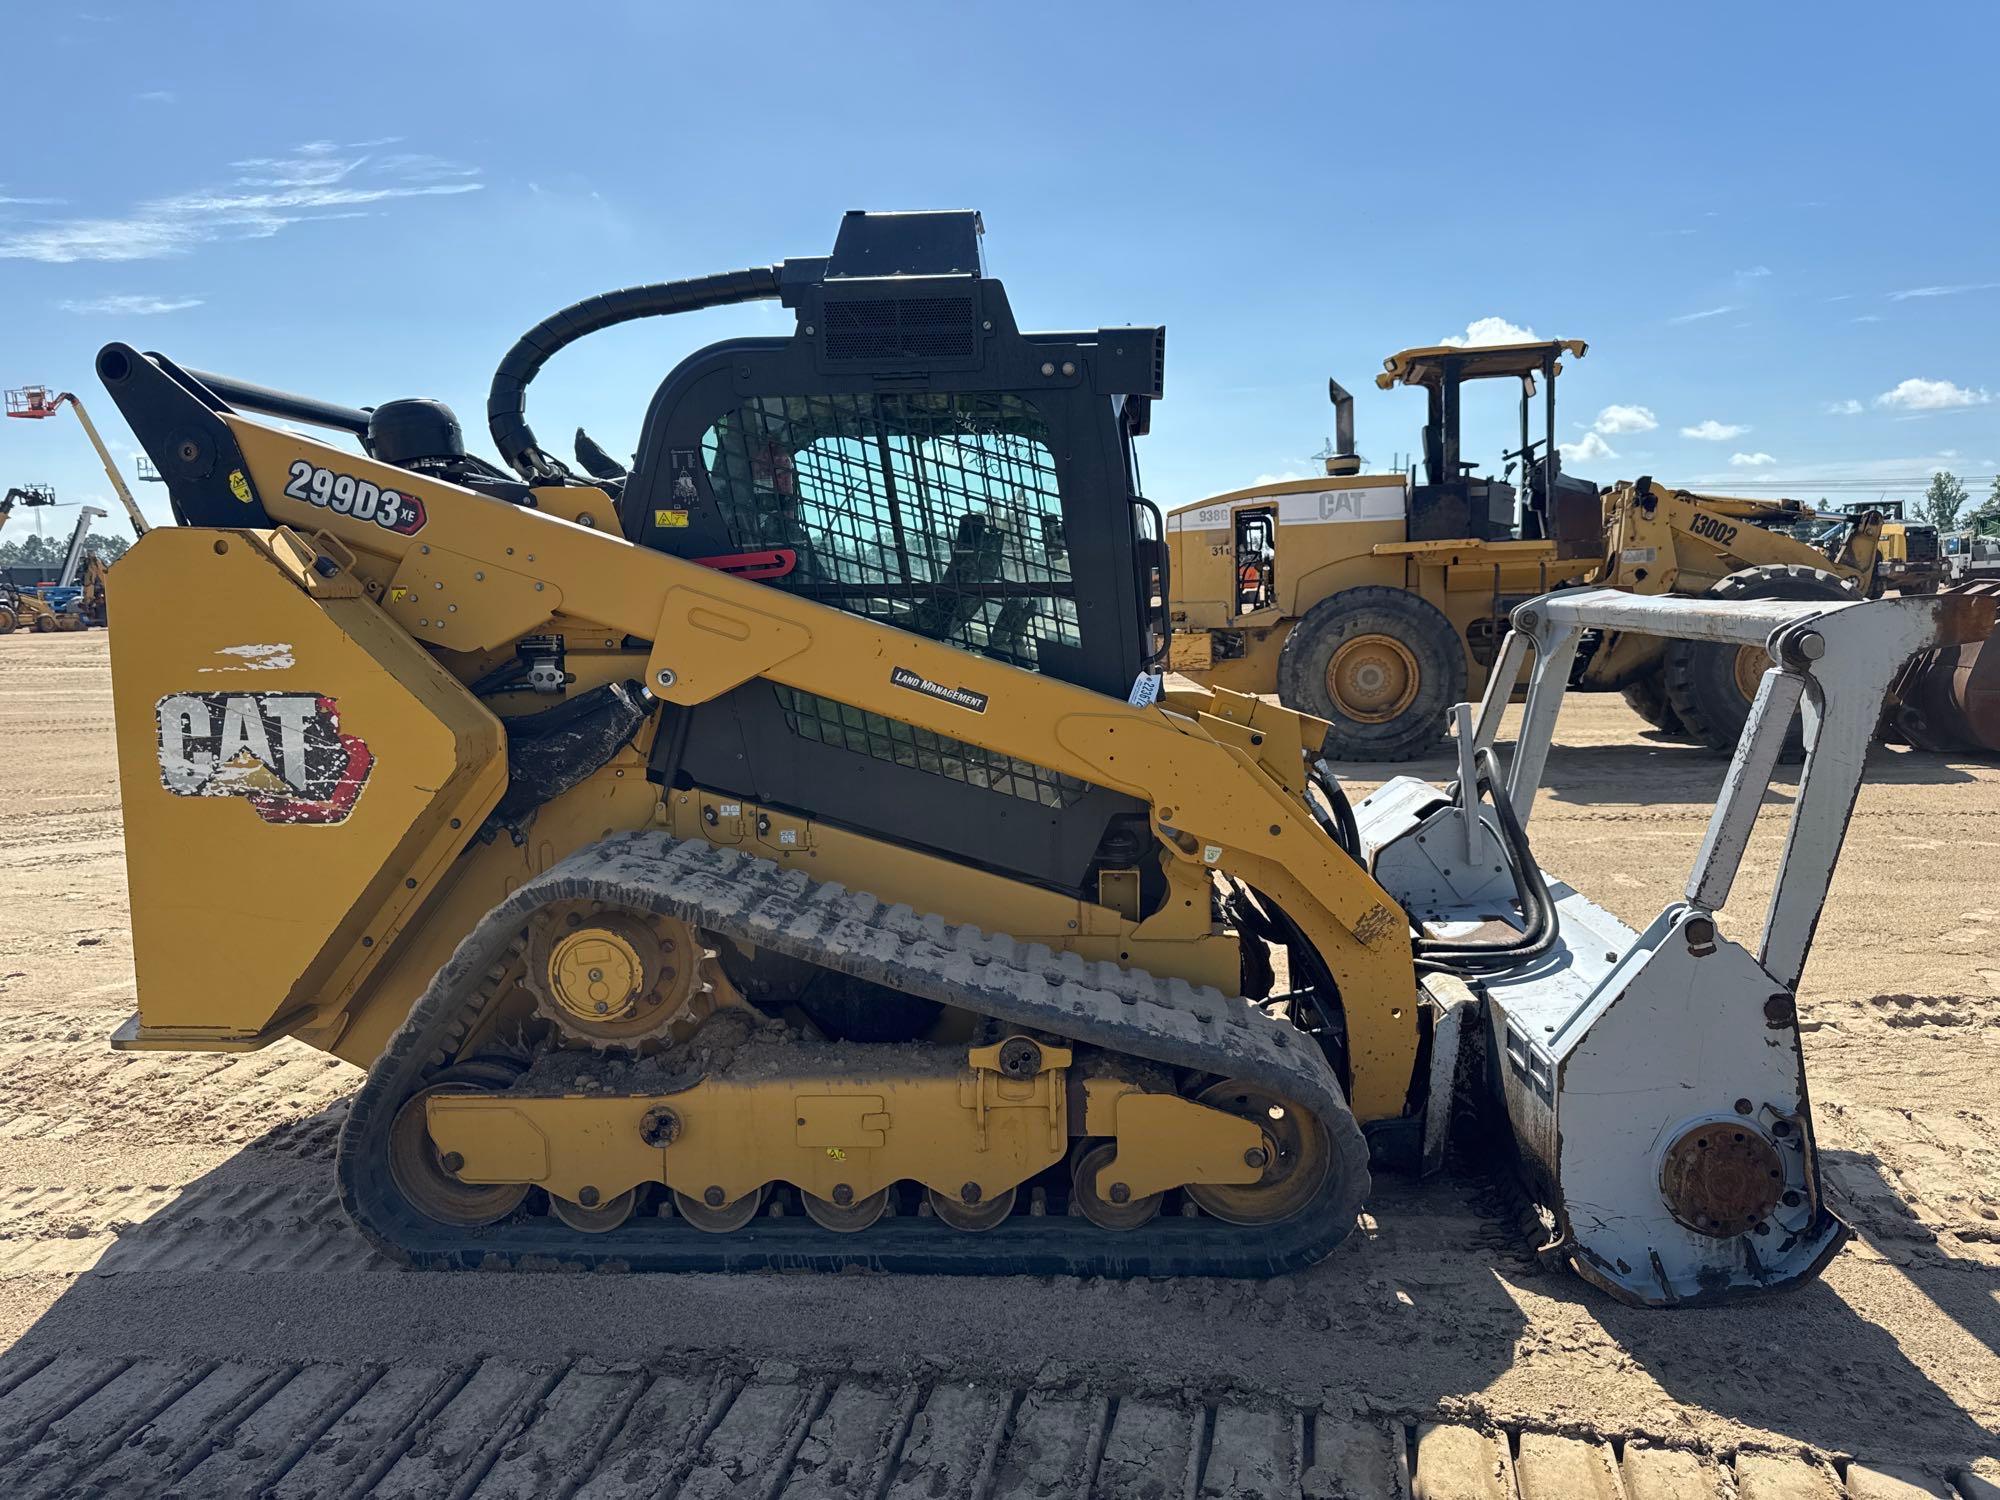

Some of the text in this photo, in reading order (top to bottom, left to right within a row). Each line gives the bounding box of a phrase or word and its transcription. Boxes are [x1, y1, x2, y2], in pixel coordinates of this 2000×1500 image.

[287, 461, 416, 526] 299D3 XE
[1319, 492, 1366, 520] CAT
[1689, 513, 1737, 546] 13002
[895, 671, 984, 707] LAND MANAGEMENT
[160, 696, 317, 792] CAT
